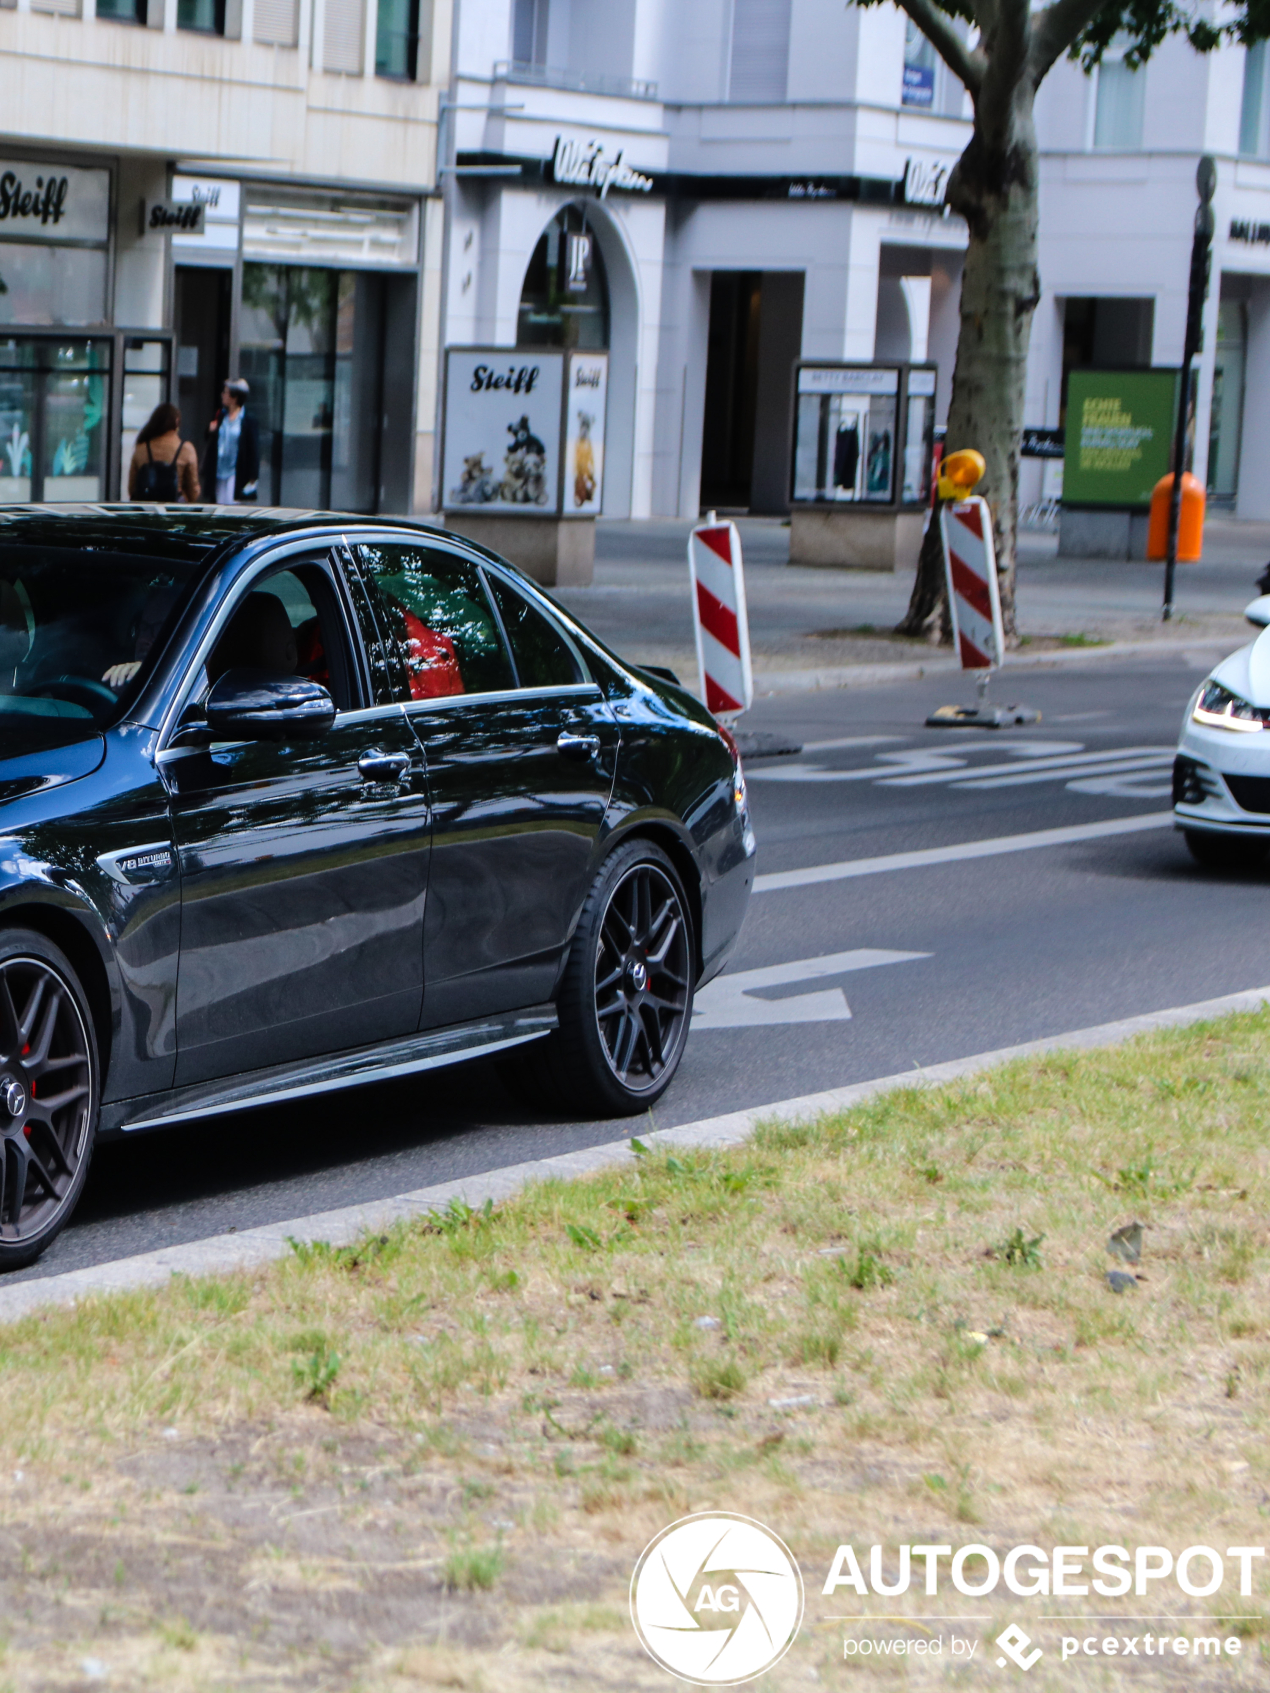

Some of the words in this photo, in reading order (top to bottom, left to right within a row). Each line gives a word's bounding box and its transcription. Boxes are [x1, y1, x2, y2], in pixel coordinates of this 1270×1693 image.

[149, 203, 203, 229] Steiff
[470, 362, 540, 394] Steiff
[575, 366, 603, 389] Steiff
[116, 859, 138, 872] V8
